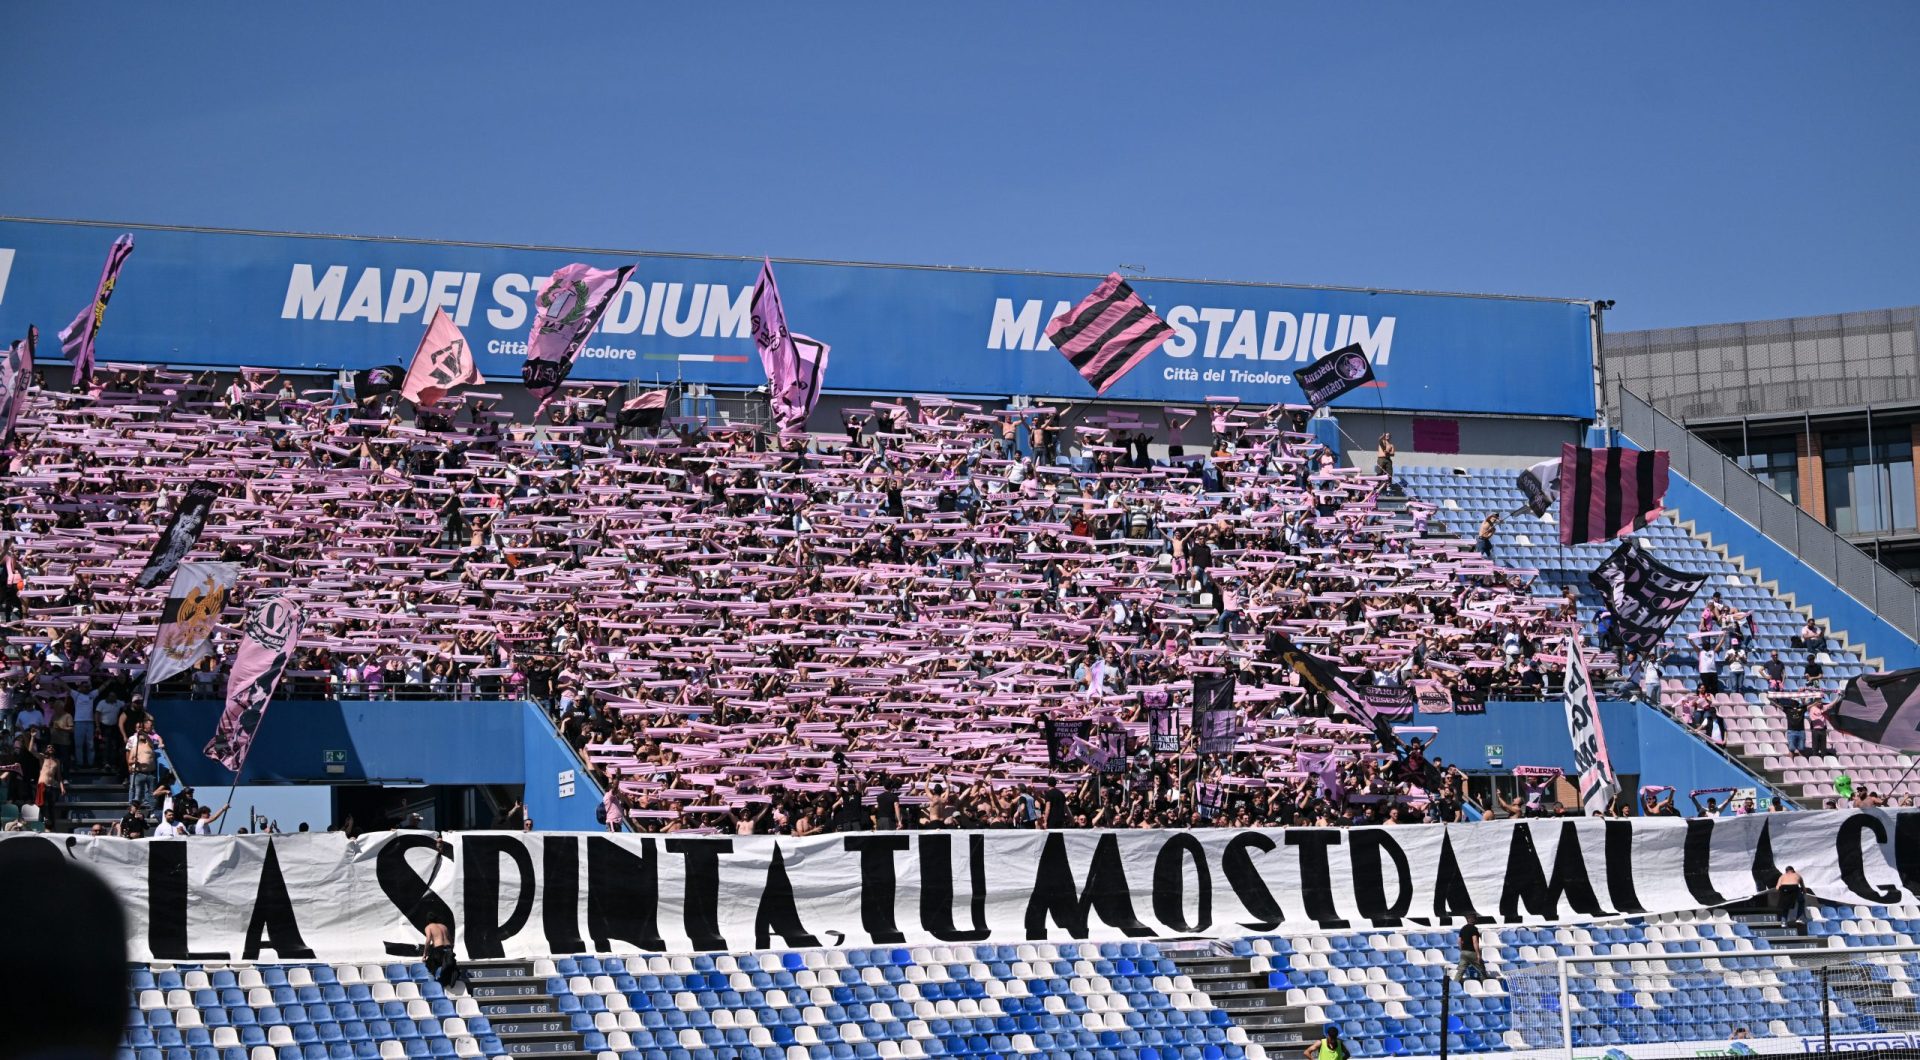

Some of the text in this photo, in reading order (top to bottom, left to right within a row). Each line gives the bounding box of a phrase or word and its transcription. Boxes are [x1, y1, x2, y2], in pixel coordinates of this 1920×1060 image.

[281, 263, 481, 326] MAPEI
[487, 273, 754, 339] SDIUM
[1162, 305, 1397, 366] STADIUM
[487, 340, 637, 360] Città icolore
[1163, 367, 1291, 385] Città del Tricolore
[1456, 703, 1484, 712] STYLE
[148, 836, 317, 960] LA
[844, 833, 992, 945] TU
[537, 1005, 547, 1013] 08
[501, 1025, 519, 1033] C 07
[549, 1023, 560, 1031] 07
